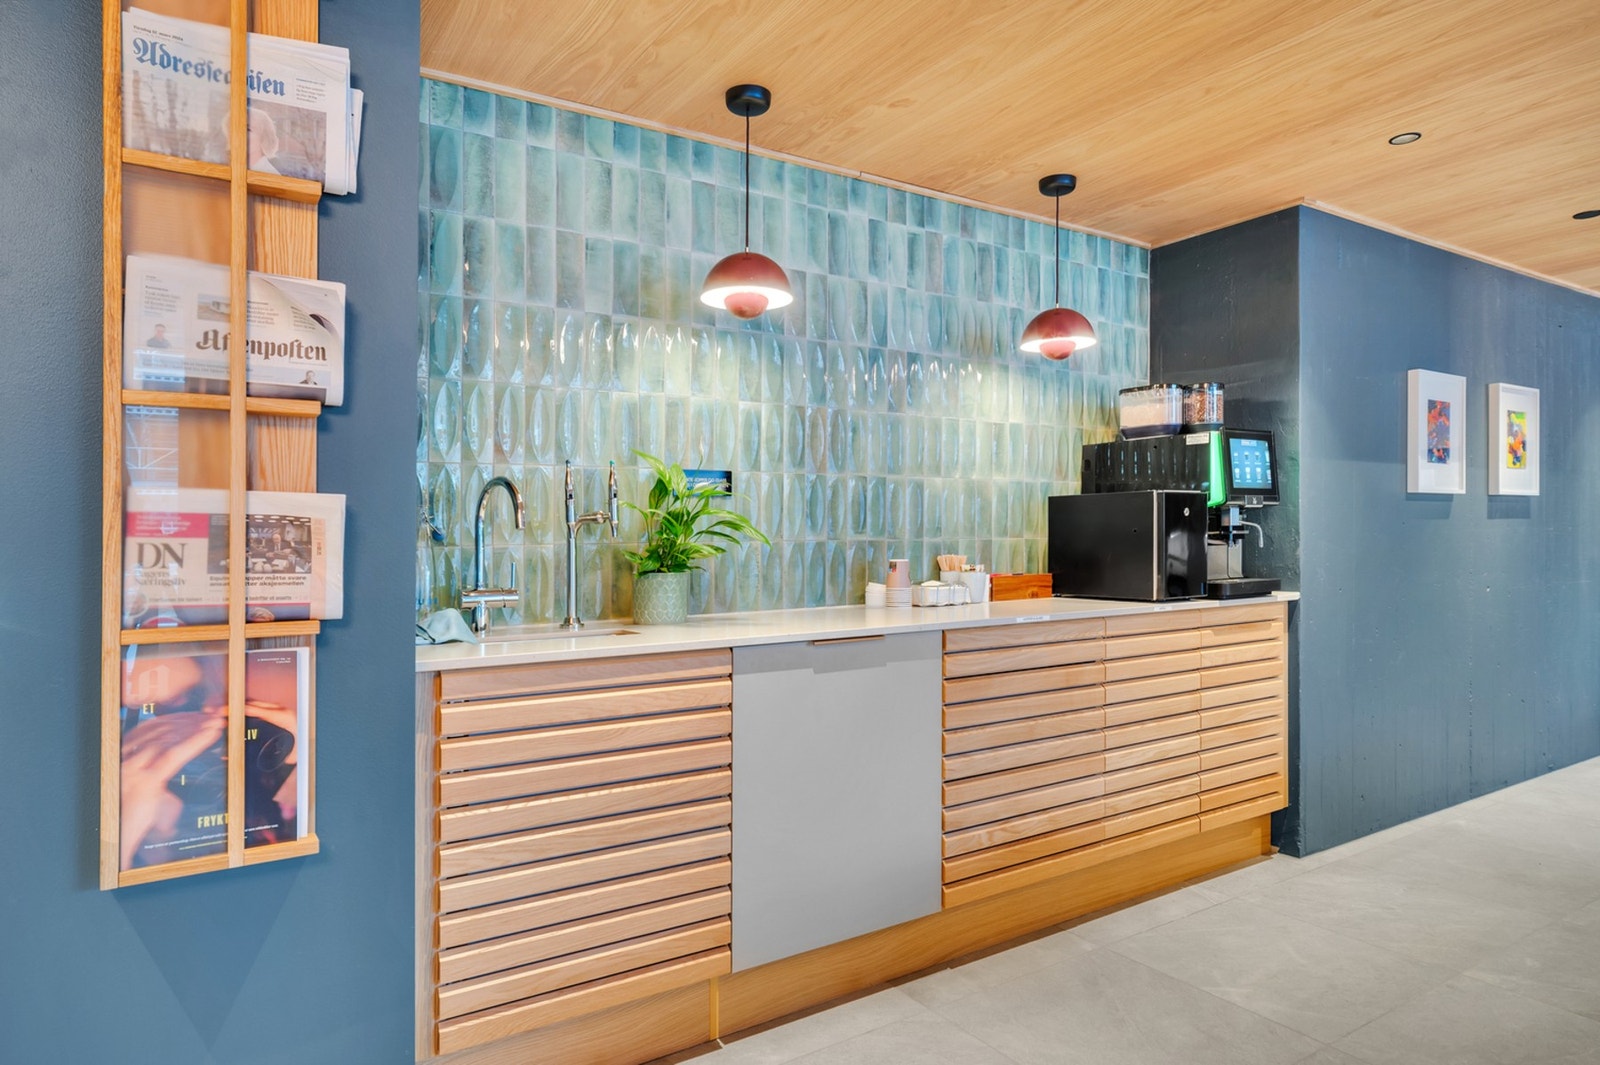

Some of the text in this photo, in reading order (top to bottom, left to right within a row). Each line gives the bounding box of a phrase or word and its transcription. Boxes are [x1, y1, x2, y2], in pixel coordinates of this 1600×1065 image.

[196, 329, 326, 361] Afnposten
[136, 542, 187, 569] DN
[143, 703, 155, 714] ET
[245, 729, 257, 740] IV
